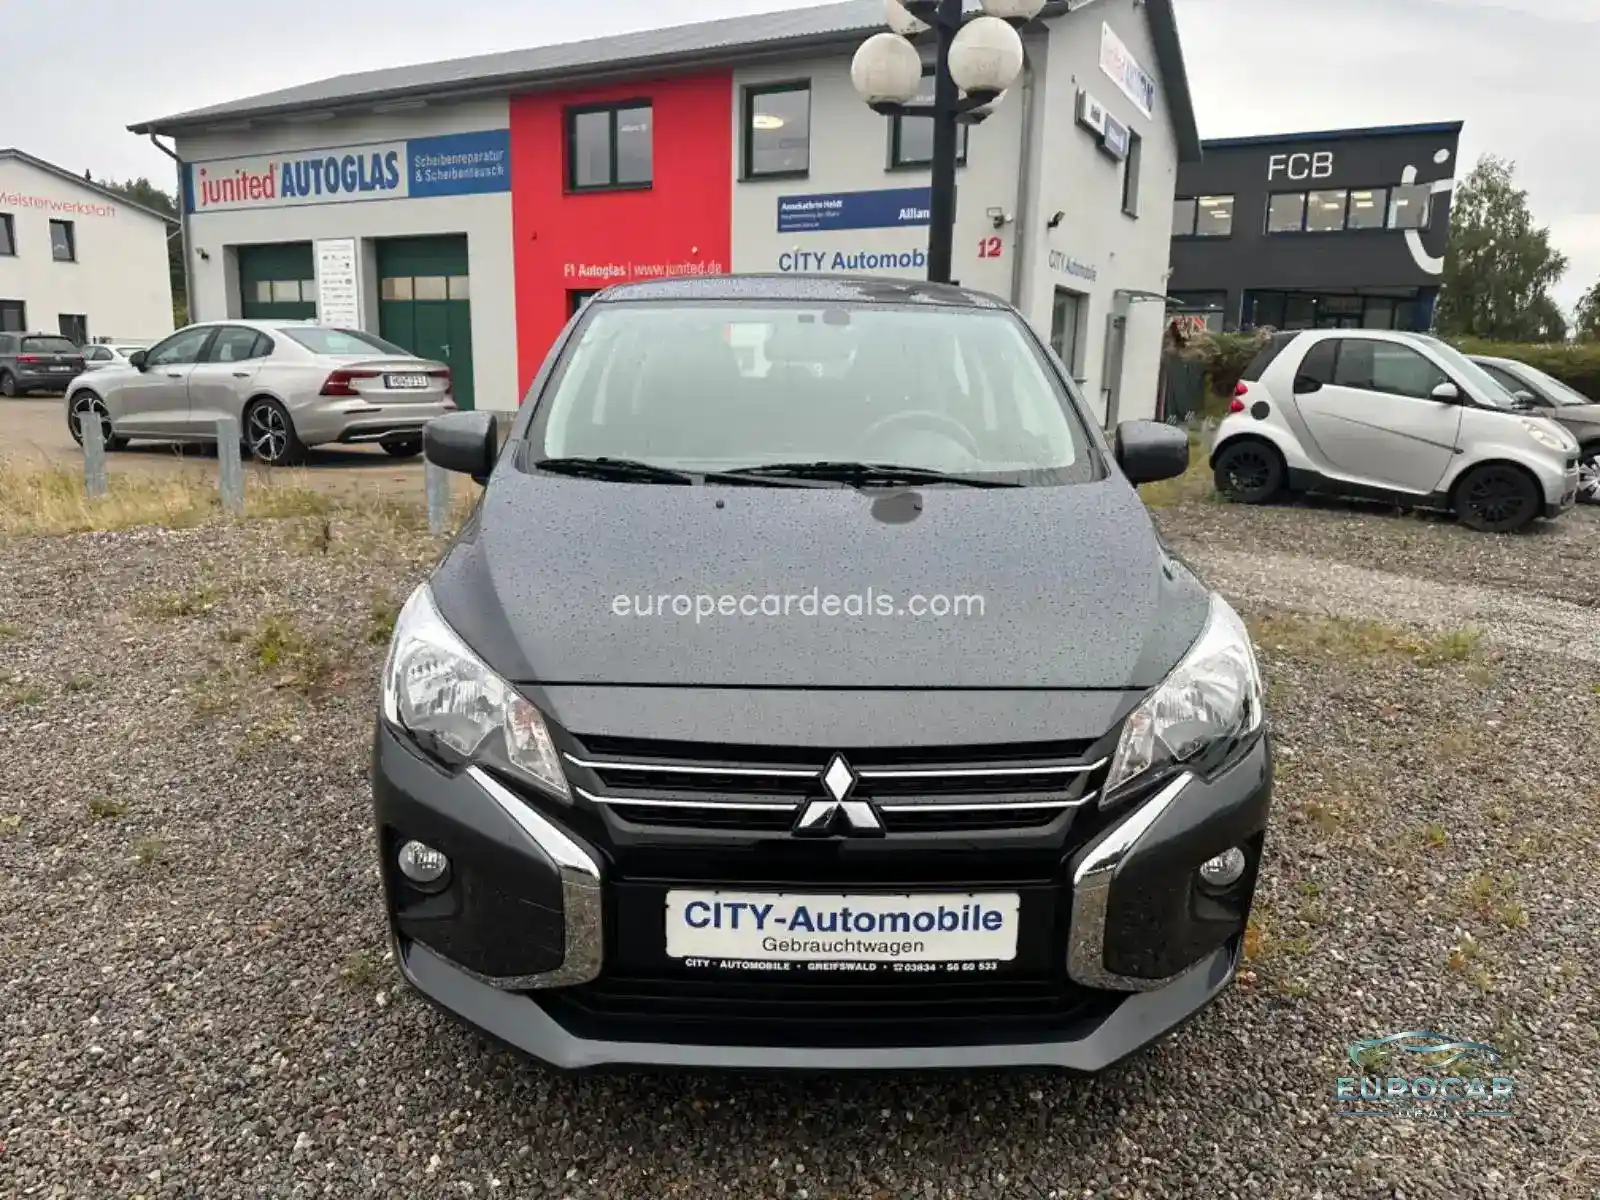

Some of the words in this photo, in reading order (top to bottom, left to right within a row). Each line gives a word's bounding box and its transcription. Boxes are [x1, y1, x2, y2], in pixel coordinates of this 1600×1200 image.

[414, 149, 504, 168] Scheibenreparatur
[1268, 151, 1333, 181] FCB
[200, 161, 275, 206] junited
[281, 150, 398, 198] AUTOGLAS
[415, 168, 423, 182] &
[898, 207, 930, 220] Allian
[978, 236, 1001, 257] 12
[778, 251, 826, 271] CITY
[831, 248, 925, 269] Automob
[578, 263, 626, 279] Autoglas
[684, 901, 1003, 933] CITY-Automobile
[762, 936, 925, 955] Gebrauchtwagen
[685, 958, 710, 968] CITY
[720, 960, 791, 971] AUTOMOBILE
[807, 962, 877, 972] GREIFSWALD
